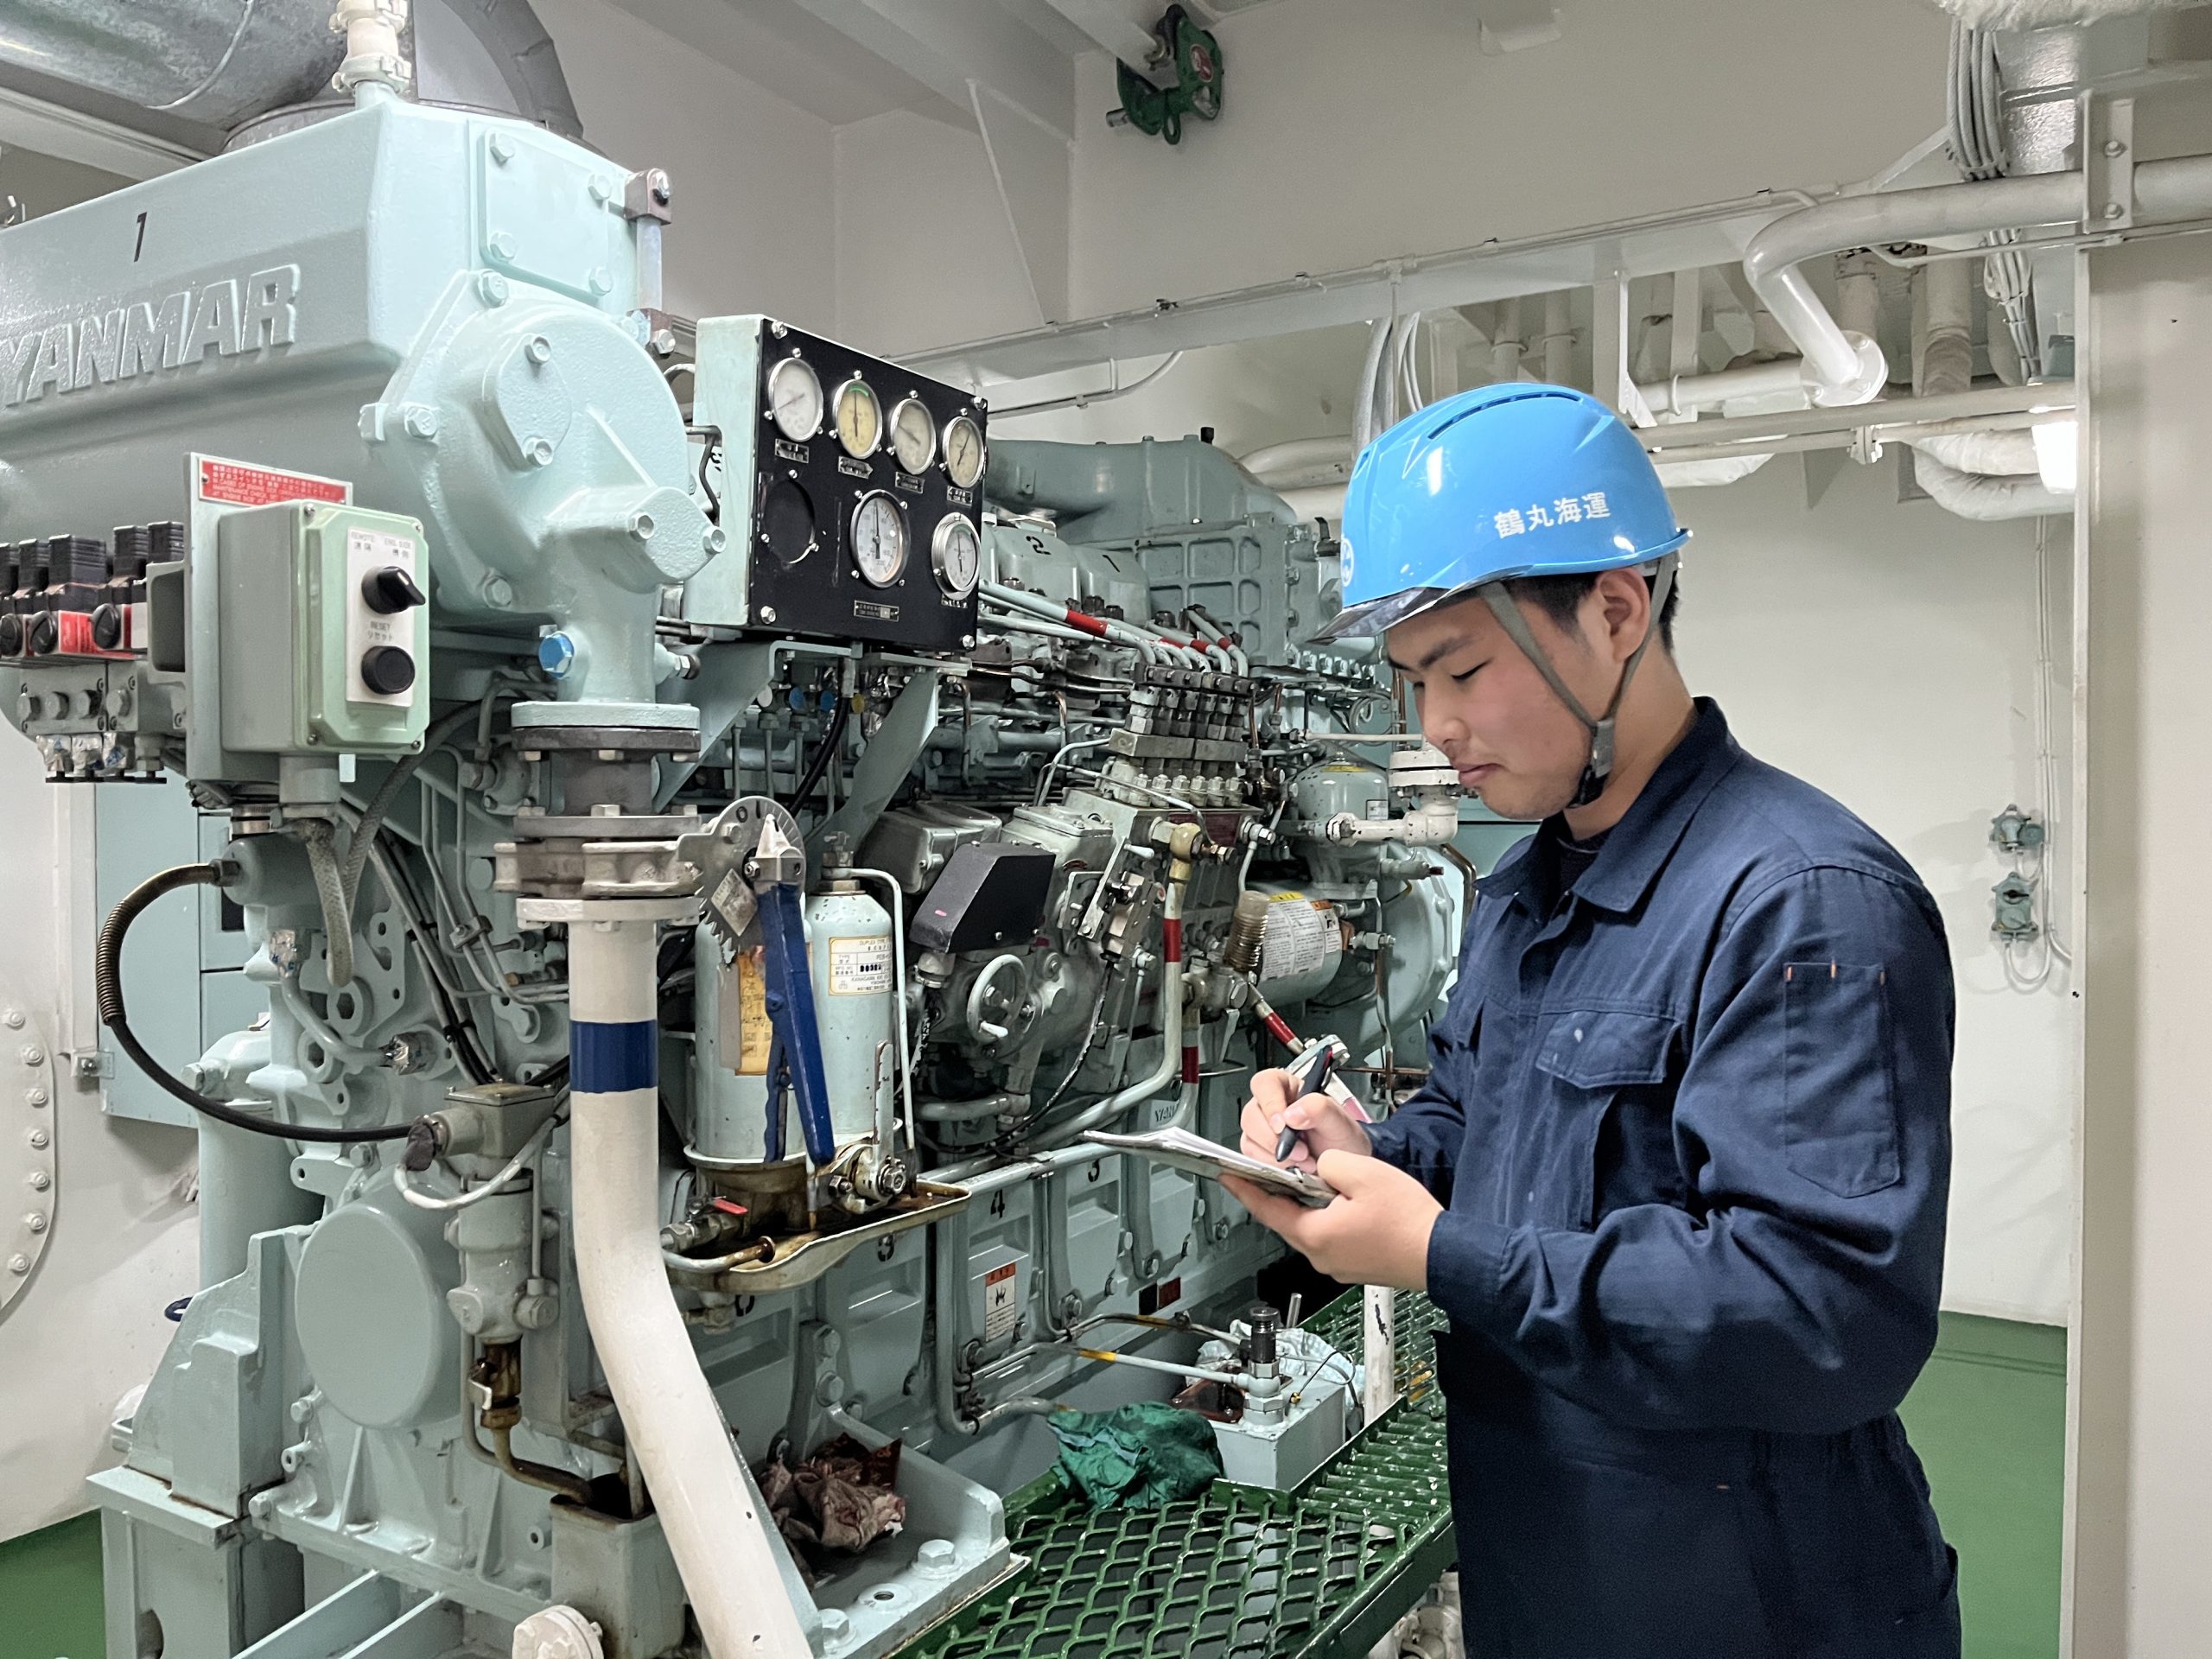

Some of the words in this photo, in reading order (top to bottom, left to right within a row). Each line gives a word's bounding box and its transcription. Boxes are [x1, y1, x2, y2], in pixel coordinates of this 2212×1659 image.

[134, 212, 148, 262] 1
[0, 263, 301, 409] YANMAR
[1493, 492, 1611, 538] 鶴丸海運
[1026, 536, 1051, 555] 2
[990, 1189, 1006, 1218] 4
